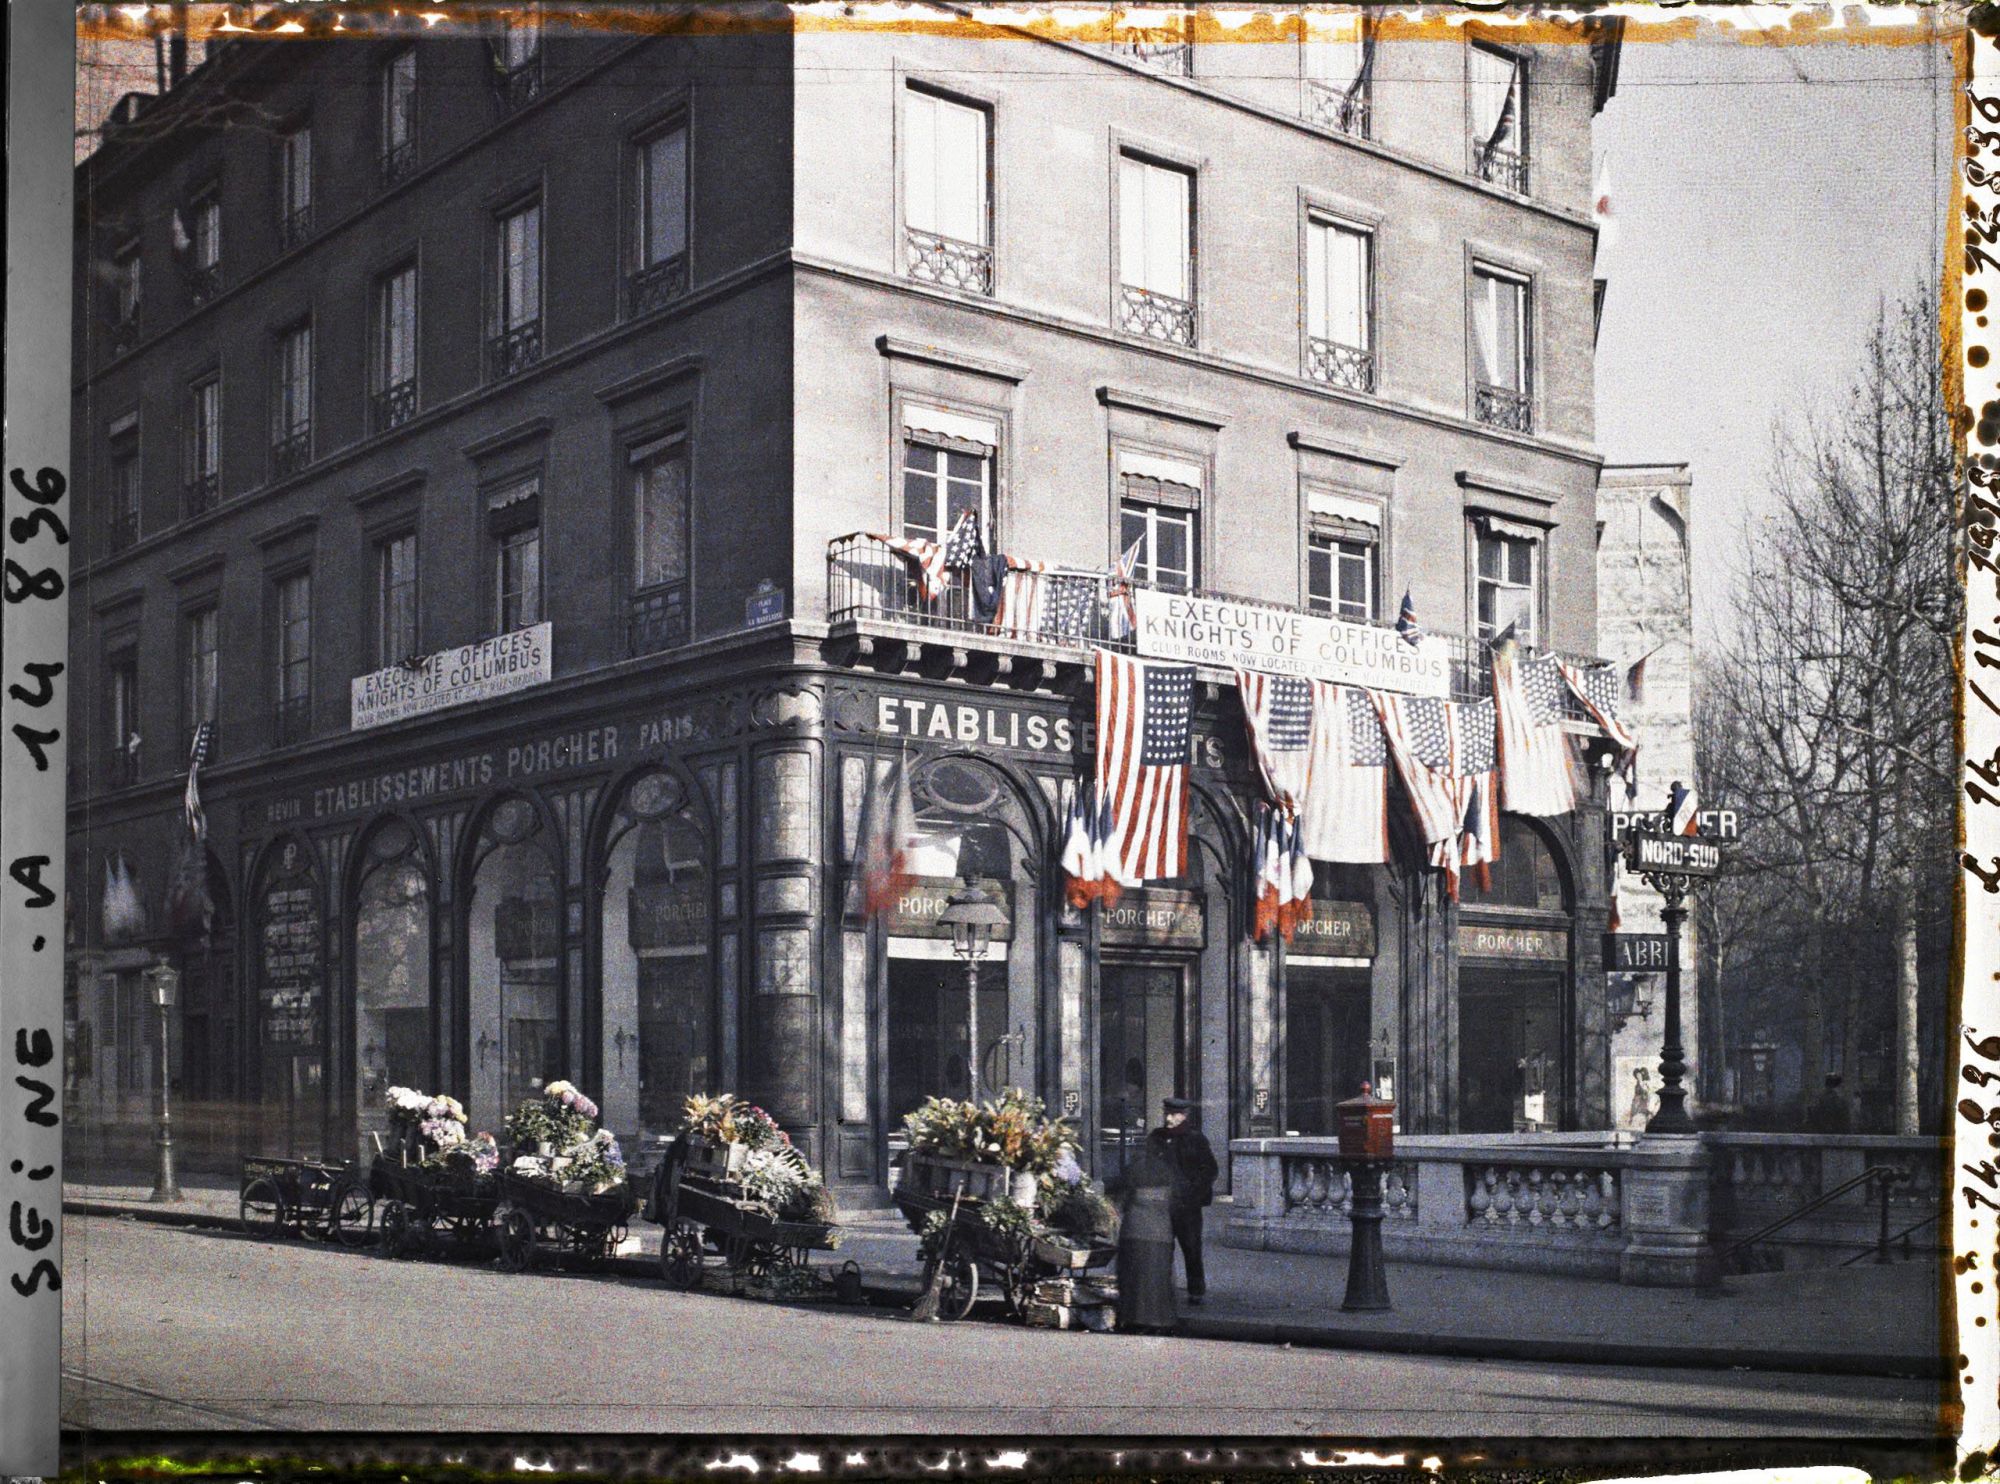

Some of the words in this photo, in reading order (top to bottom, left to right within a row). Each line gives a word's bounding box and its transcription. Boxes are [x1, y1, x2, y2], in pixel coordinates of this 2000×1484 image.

[3, 466, 67, 606] 836
[1169, 598, 1303, 637] EXECUTIVE
[1329, 624, 1421, 657] OFFICES
[460, 630, 533, 667] OFFICES
[1145, 615, 1254, 650] KNIGHTS
[1272, 634, 1301, 656] OF
[1319, 642, 1443, 678] COLUMBUS
[1151, 640, 1181, 656] CLUB
[1187, 645, 1226, 662] ROOMS
[1232, 653, 1257, 667] NOW
[1261, 656, 1306, 674] LOCATED
[356, 681, 416, 712] KNIGHTS
[423, 675, 442, 694] OF
[450, 646, 542, 688] COLUMBUS
[314, 752, 493, 818] ETABLISSEMENTS
[507, 725, 619, 778] PORCHER
[639, 714, 694, 751] PARIS
[1641, 838, 1720, 869] NORD-SUD
[1105, 907, 1177, 928] PORCHER
[1477, 933, 1544, 952] PORCHER
[1622, 938, 1670, 967] ABRI
